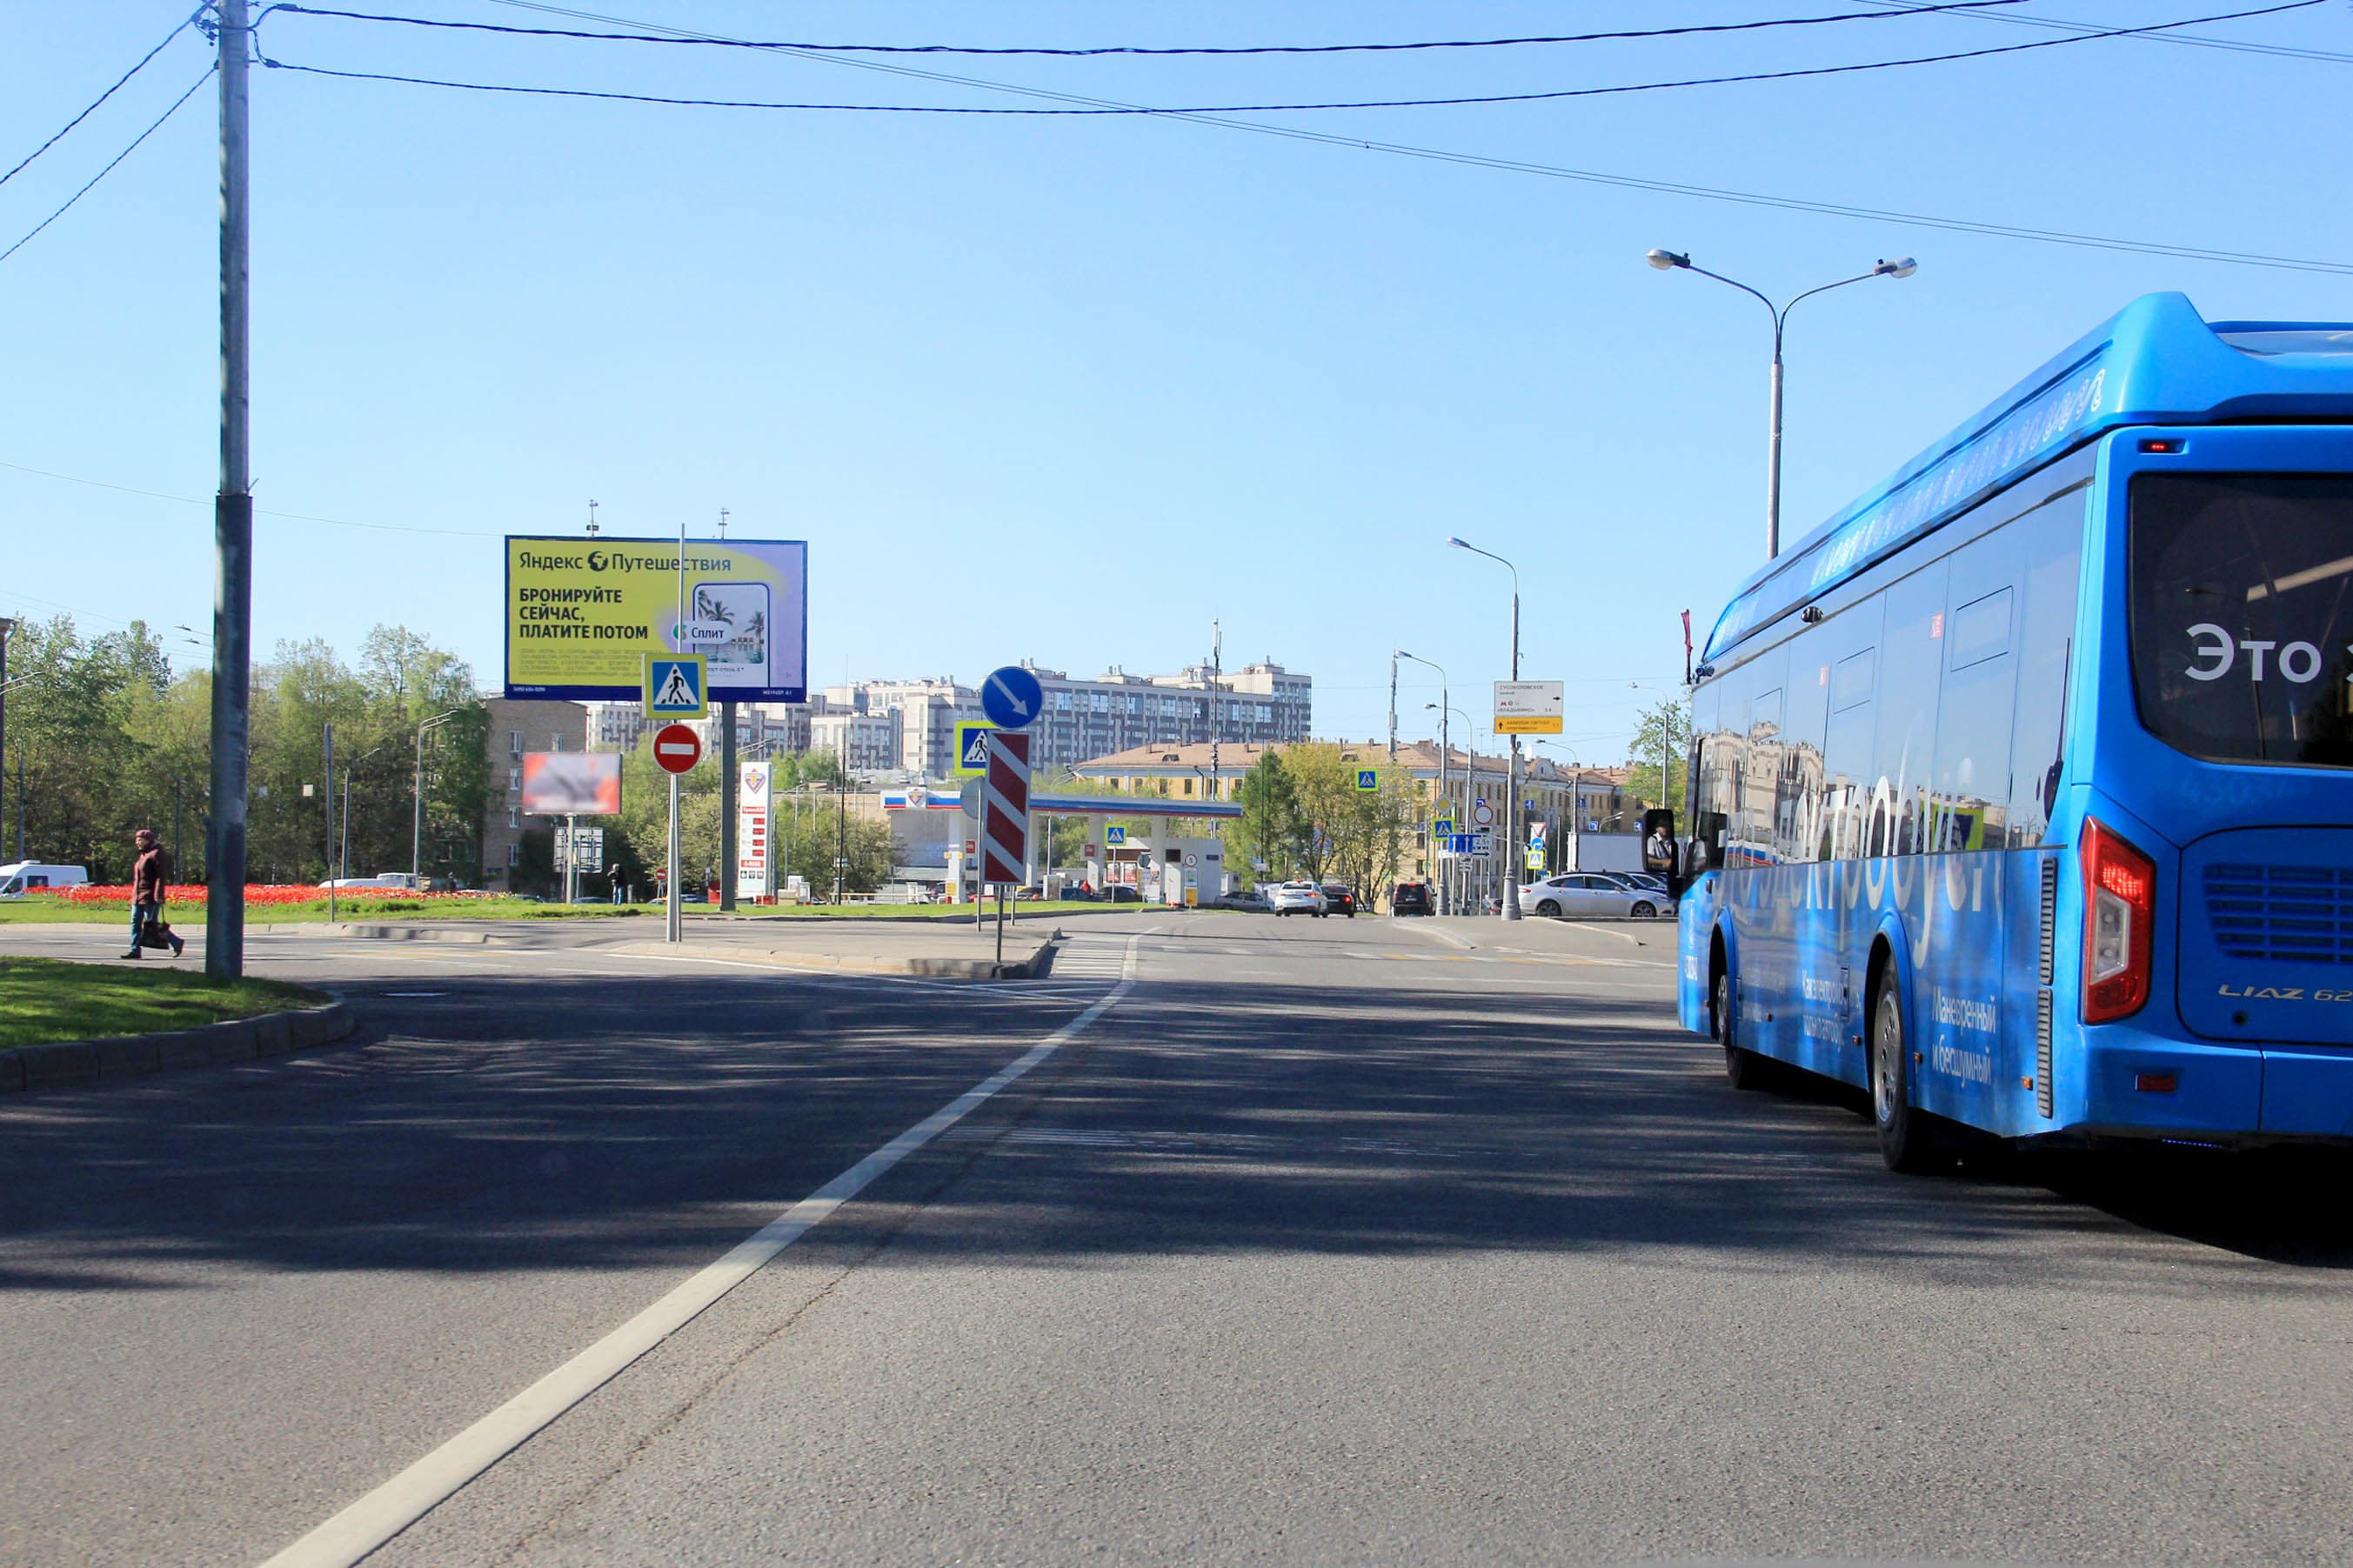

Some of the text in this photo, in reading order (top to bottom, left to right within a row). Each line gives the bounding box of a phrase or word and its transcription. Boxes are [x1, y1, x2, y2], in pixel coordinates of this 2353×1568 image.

[519, 551, 732, 573] Яндекс Путешествия
[519, 586, 623, 604] БРОНИРУЙТЕ
[519, 604, 585, 622] СЕЙЧАС,
[519, 624, 649, 640] ПЛАТИТЕ ПОТОМ
[691, 626, 725, 640] Сплит
[2184, 621, 2323, 684] Это
[2217, 984, 2304, 1000] LIAZ
[1932, 986, 1996, 1037] Маневренный
[1932, 1033, 1991, 1088] и бесшумный
